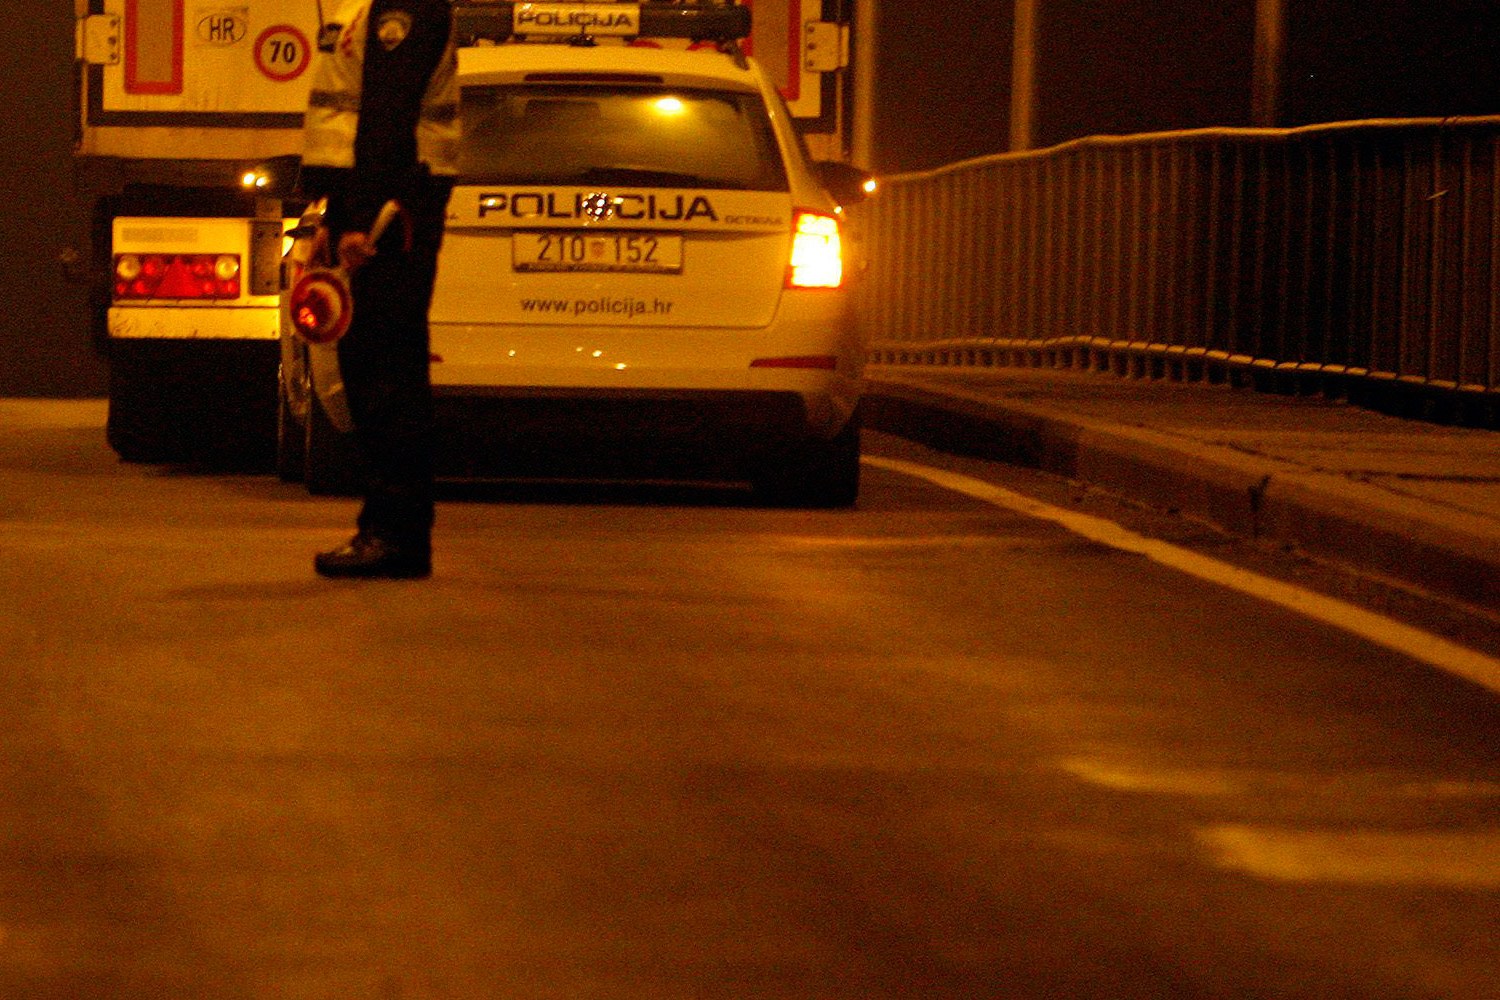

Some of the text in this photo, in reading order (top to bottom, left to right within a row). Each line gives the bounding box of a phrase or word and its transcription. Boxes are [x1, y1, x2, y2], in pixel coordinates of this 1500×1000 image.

[208, 17, 235, 42] HR
[517, 11, 633, 28] POLICIJA
[269, 40, 296, 64] 70
[478, 192, 719, 222] POLICIJA
[537, 234, 659, 264] 210 152
[520, 298, 673, 318] www.policija.hr
